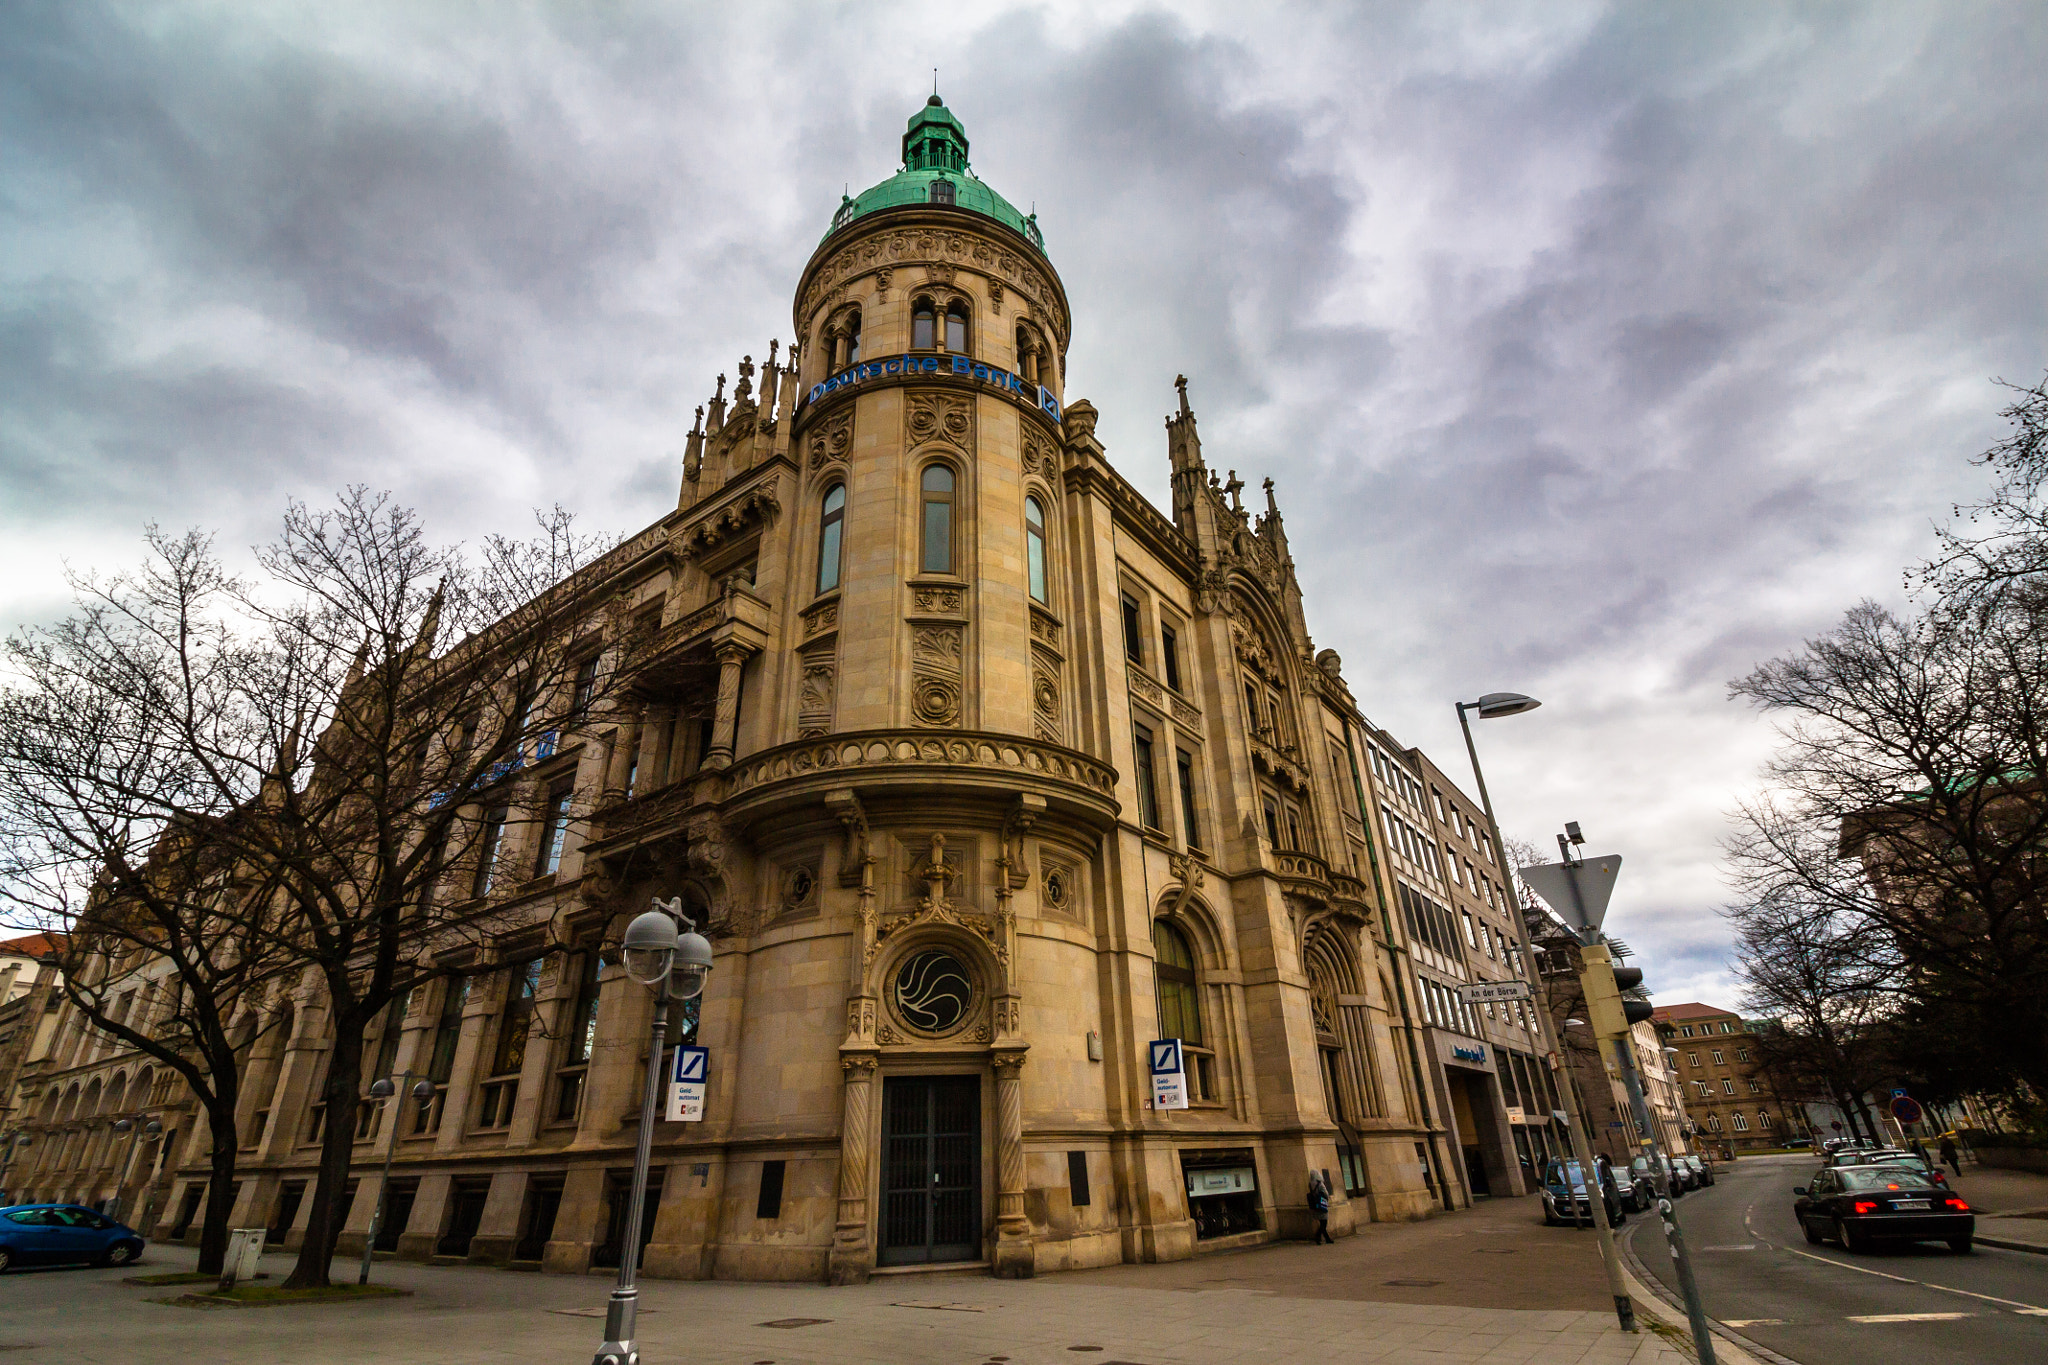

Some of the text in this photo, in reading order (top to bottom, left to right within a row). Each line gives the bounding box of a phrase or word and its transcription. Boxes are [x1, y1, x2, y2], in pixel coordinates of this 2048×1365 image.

[809, 354, 1024, 405] Deutsche Bank
[1471, 986, 1518, 998] An der Börse
